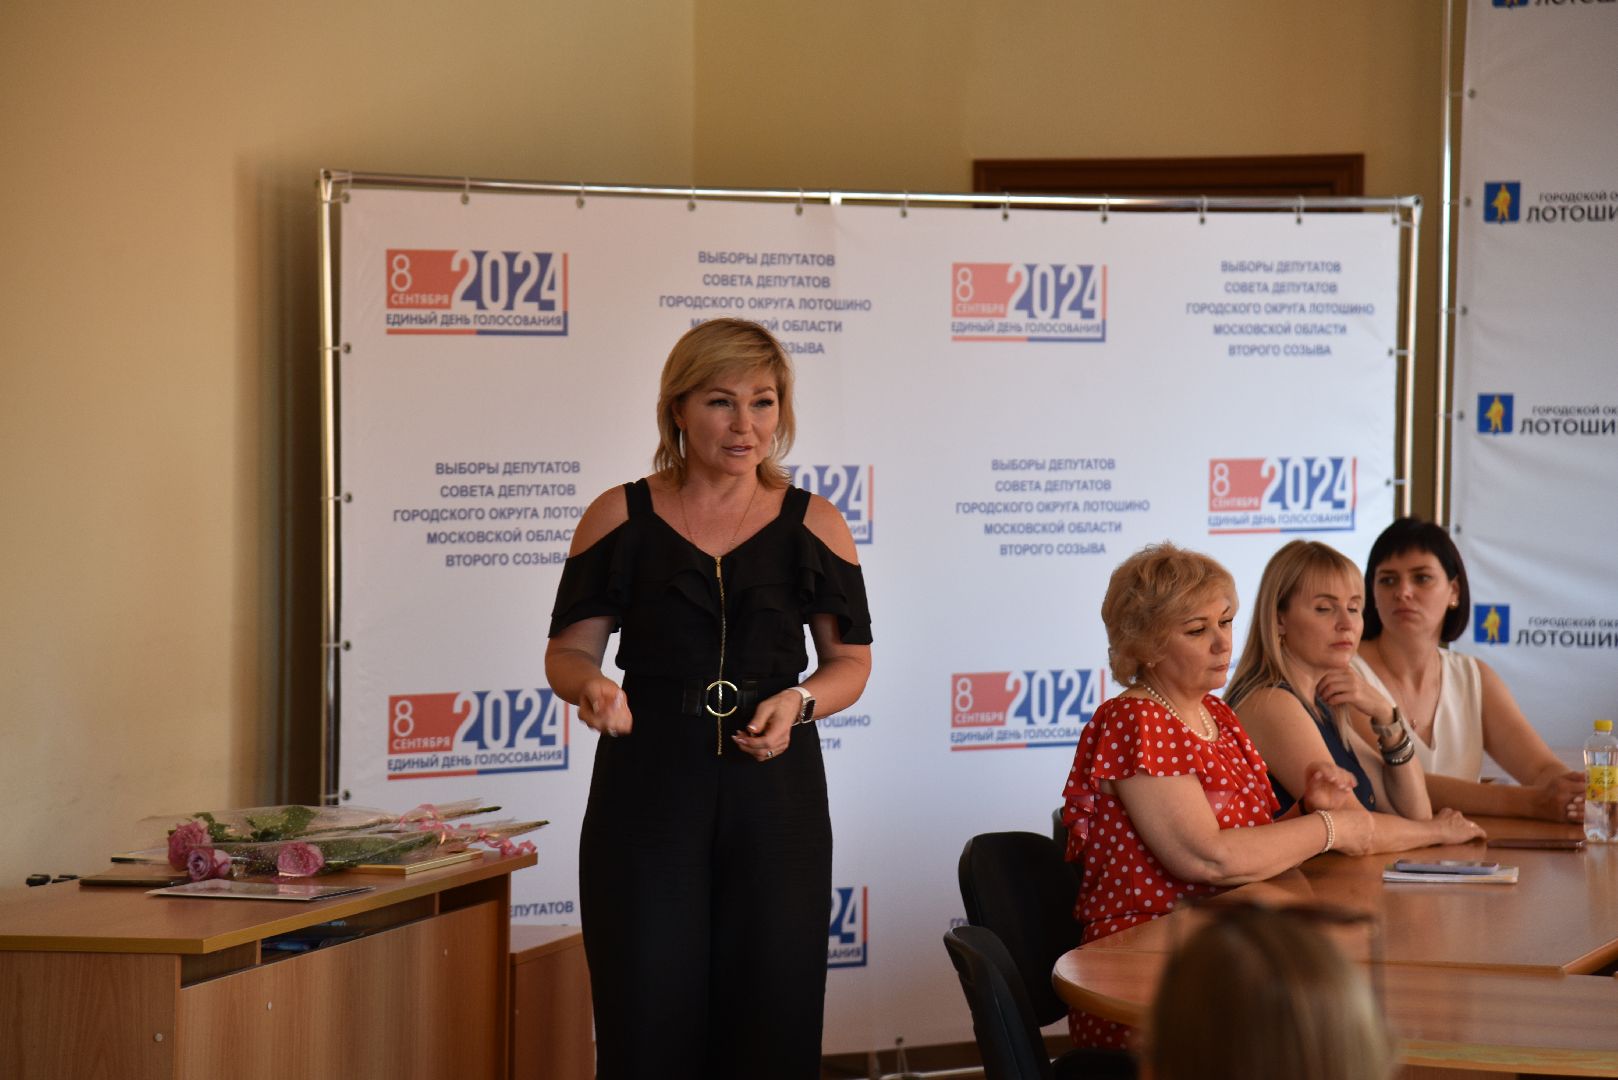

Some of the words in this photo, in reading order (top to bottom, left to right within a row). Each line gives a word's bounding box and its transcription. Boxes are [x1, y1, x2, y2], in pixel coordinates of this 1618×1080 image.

[1540, 191, 1607, 202] ГОРОДСКОЙ
[1526, 205, 1618, 222] ЛОТОШИ
[698, 251, 757, 265] ВЫБОРЫ
[760, 252, 836, 267] ДЕПУТАТОВ
[391, 254, 412, 292] 8
[1221, 261, 1273, 273] ВЫБОРЫ
[1276, 261, 1341, 274] ДЕПУТАТОВ
[451, 250, 562, 311] 2024
[703, 274, 753, 287] СОВЕТА
[756, 275, 831, 289] ДЕПУТАТОВ
[956, 267, 974, 302] 8
[1224, 282, 1269, 293] СОВЕТА
[1271, 282, 1338, 294] ДЕПУТАТОВ
[1007, 263, 1101, 319] 2024
[391, 294, 449, 305] СЕНТЯБРЯ
[659, 296, 744, 310] ГОРОДСКОГО
[748, 297, 795, 310] ОКРУГА
[799, 298, 872, 311] ЛОТОШИНО
[1186, 303, 1261, 315] ГОРОДСКОГО
[1264, 303, 1305, 315] ОКРУГА
[1309, 303, 1375, 315] ЛОТОШИНО
[386, 312, 437, 326] ЕДИНЫЙ
[440, 314, 470, 327] ДЕНЬ
[473, 314, 562, 326] ГОЛОСОВАНИЯ
[782, 319, 842, 333] ОБЛАСТИ
[951, 320, 994, 333] ЕДИНЫЙ
[997, 322, 1022, 333] ДЕНЬ
[1025, 322, 1100, 333] ГОЛОСОВАНИЯ
[1213, 322, 1291, 335] МОСКОВСКОЙ
[1294, 324, 1347, 335] ОБЛАСТИ
[1229, 345, 1280, 356] ВТОРОГО
[1283, 345, 1331, 356] СОЗЫВА
[1532, 404, 1599, 415] ГОРОДСКОЙ
[1520, 418, 1616, 435] ЛОТОШИ
[436, 462, 499, 475] ВЫБОРЫ
[502, 461, 580, 475] ДЕПУТАТОВ
[992, 459, 1045, 471] ВЫБОРЫ
[1048, 458, 1115, 471] ДЕПУТАТОВ
[995, 480, 1041, 492] СОВЕТА
[1044, 479, 1111, 493] ДЕПУТАТОВ
[1212, 463, 1230, 497] 8
[1261, 457, 1351, 510] 2024
[440, 485, 495, 498] СОВЕТА
[498, 484, 576, 499] ДЕПУТАТОВ
[394, 508, 485, 522] ГОРОДСКОГО
[489, 507, 539, 521] ОКРУГА
[543, 506, 586, 520] ЛОТО
[956, 501, 1033, 515] ГОРОДСКОГО
[1037, 501, 1080, 513] ОКРУГА
[1083, 500, 1150, 512] ЛОТОШИНО
[1208, 513, 1249, 526] ЕДИНЫЙ
[1251, 515, 1276, 525] ДЕНЬ
[1278, 514, 1350, 524] ГОЛОСОВАНИЯ
[984, 521, 1064, 534] МОСКОВСКОЙ
[1068, 522, 1122, 534] ОБЛАСТИ
[427, 528, 522, 544] МОСКОВСКОЙ
[526, 529, 576, 542] ОБЛАС
[1000, 544, 1053, 556] ВТОРОГО
[1056, 543, 1106, 555] СОЗЫВА
[446, 553, 509, 567] ВТОРОГО
[513, 552, 569, 565] СОЗЫВА
[1516, 629, 1618, 648] ЛОТОШИ
[955, 678, 973, 712] 8
[1006, 669, 1100, 725] 2024
[393, 700, 414, 737] 8
[453, 688, 564, 750] 2024
[955, 712, 1004, 724] СЕНТЯБРЯ
[393, 736, 450, 750] СЕНТЯБРЯ
[951, 728, 994, 743] ЕДИНЫЙ
[996, 730, 1021, 741] ДЕНЬ
[1024, 728, 1080, 739] ГОЛОСОВА
[387, 754, 439, 771] ЕДИНЫЙ
[441, 755, 471, 769] ДЕНЬ
[474, 750, 562, 765] ГОЛОСОВАНИЯ
